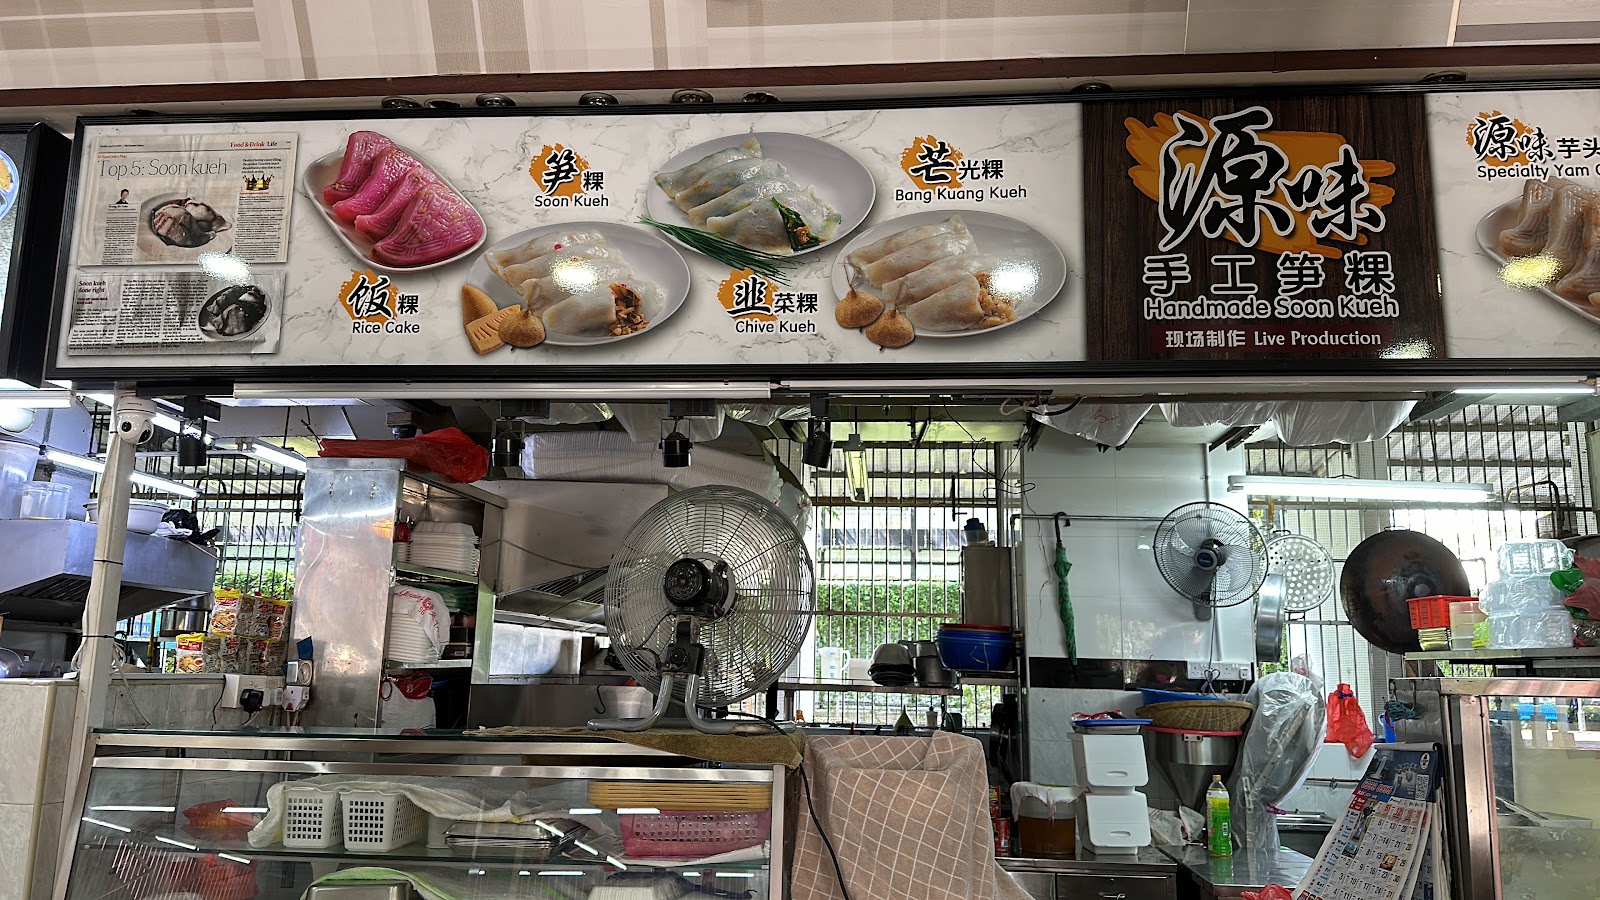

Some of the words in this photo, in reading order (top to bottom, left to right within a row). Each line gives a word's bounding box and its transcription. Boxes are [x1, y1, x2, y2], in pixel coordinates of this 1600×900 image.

[98, 159, 128, 181] Top
[130, 159, 145, 176] 5:
[148, 158, 188, 176] Soon
[190, 158, 227, 176] kueh
[1477, 163, 1550, 182] Specialty
[1553, 163, 1590, 177] Yam
[534, 195, 570, 208] Soon
[573, 194, 610, 207] Kueh
[895, 188, 933, 204] Bang
[937, 186, 985, 203] Kuang
[989, 184, 1028, 199] Kueh
[1144, 296, 1271, 319] Handmade
[1275, 296, 1335, 318] Soon
[1338, 294, 1399, 318] Kueh
[352, 321, 382, 335] Rice
[385, 321, 421, 334] Cake
[735, 320, 775, 333] Chive
[779, 319, 816, 333] Kueh
[1165, 329, 1246, 348] 现场制作
[1253, 331, 1287, 346] Live
[1290, 331, 1382, 346] Production
